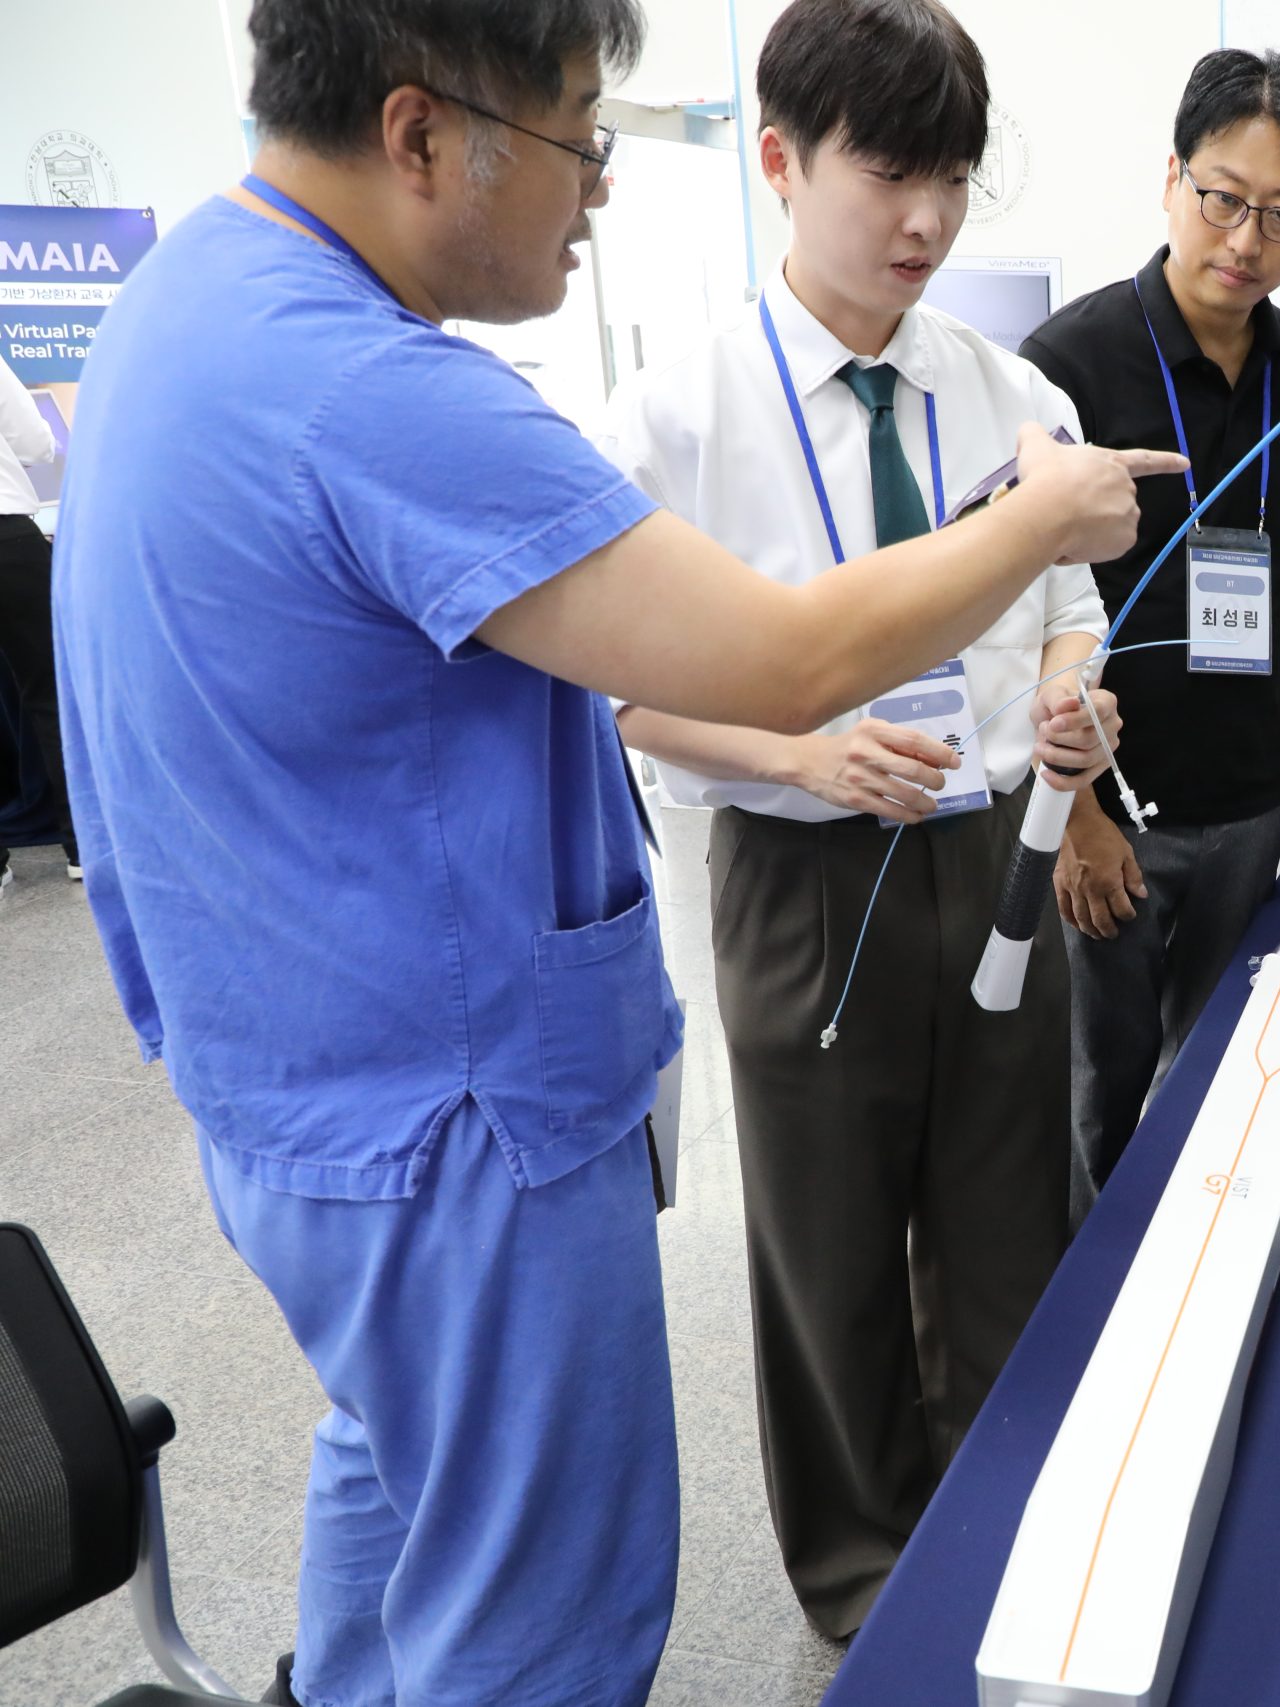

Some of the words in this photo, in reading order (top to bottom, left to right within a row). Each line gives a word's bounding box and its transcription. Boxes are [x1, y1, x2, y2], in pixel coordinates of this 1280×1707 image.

[964, 212, 1003, 225] NIVERSITY
[0, 241, 121, 273] MAIA
[5, 323, 69, 339] Virtual
[10, 343, 52, 359] Real
